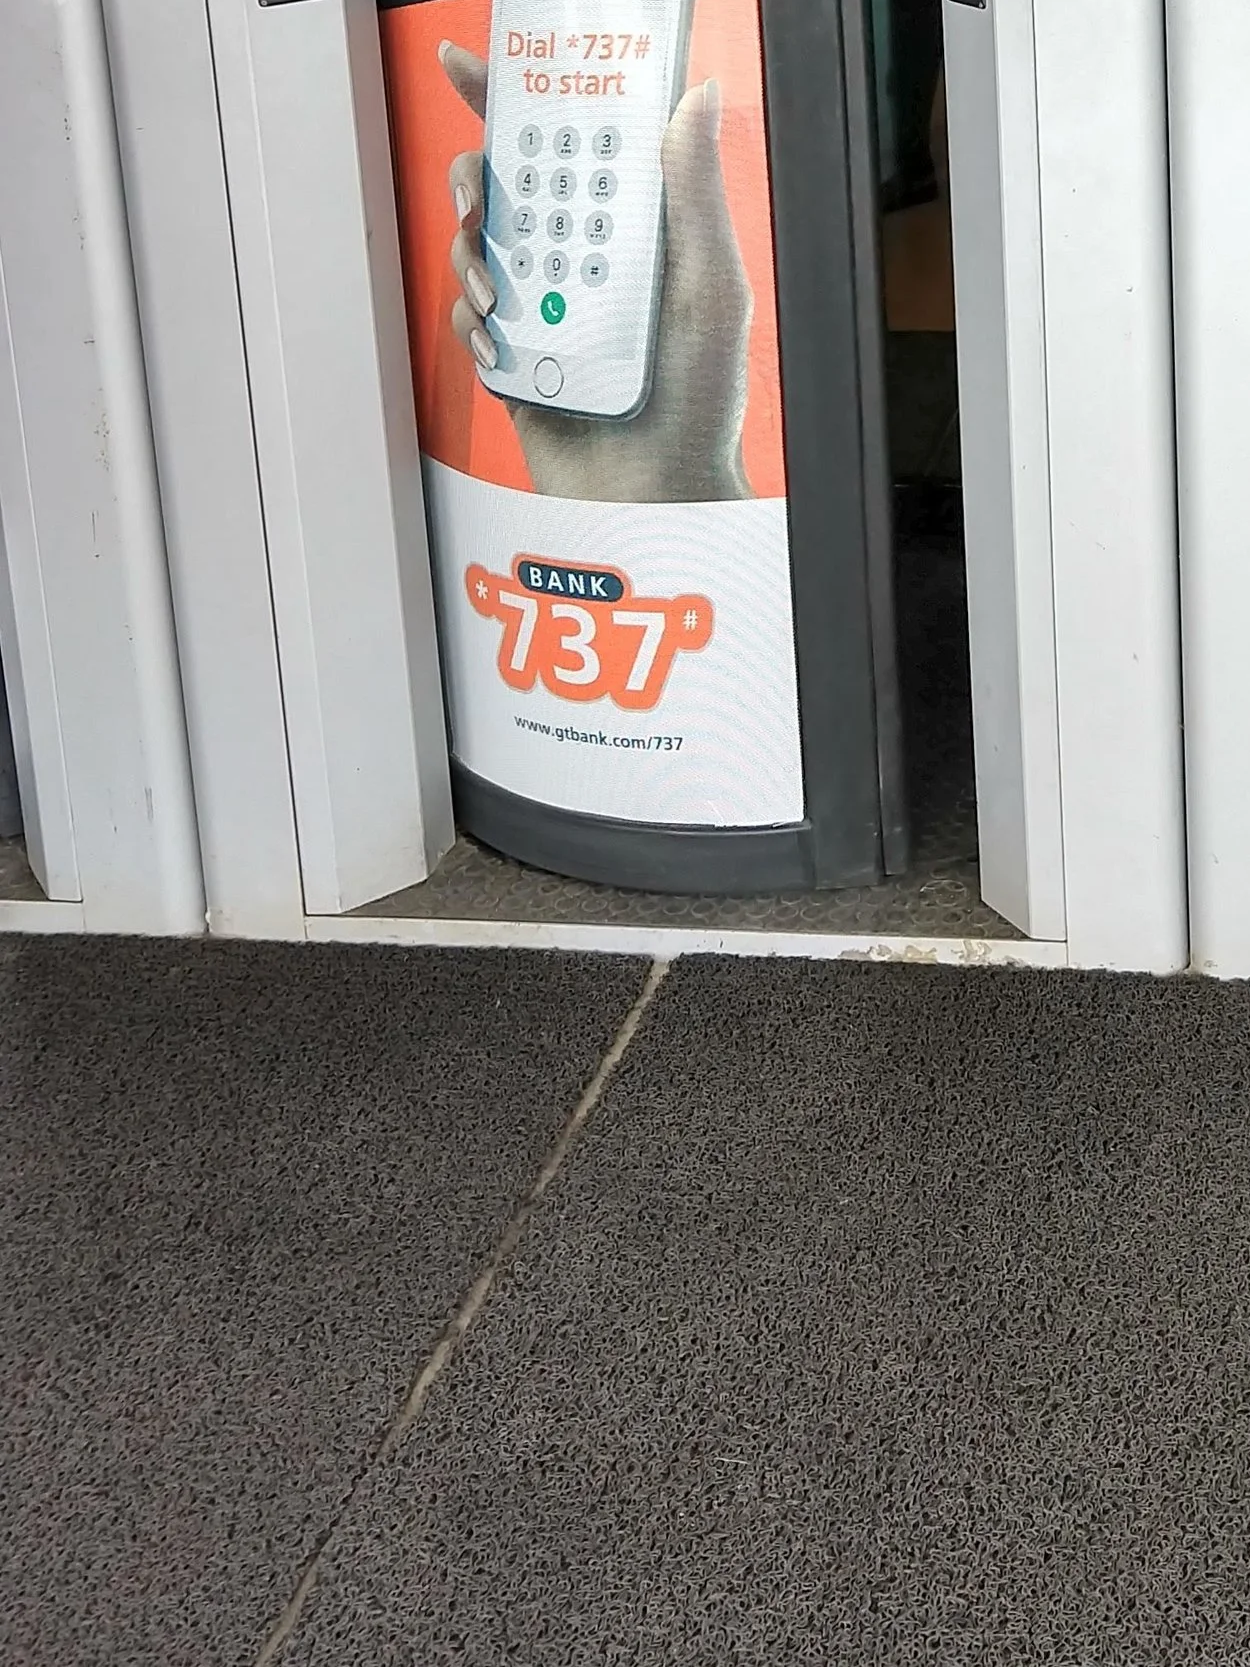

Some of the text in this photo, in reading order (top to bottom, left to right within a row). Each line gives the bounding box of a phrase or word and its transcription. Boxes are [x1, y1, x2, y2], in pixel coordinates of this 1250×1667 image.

[506, 31, 556, 60] Dial
[523, 68, 626, 96] to start
[527, 132, 612, 148] 1 2 3
[523, 173, 608, 190] 4 5 6
[520, 213, 604, 233] 7 8 9
[551, 257, 562, 272] 0
[529, 566, 609, 598] BANK
[513, 715, 684, 752] www.gtbank.com/737
